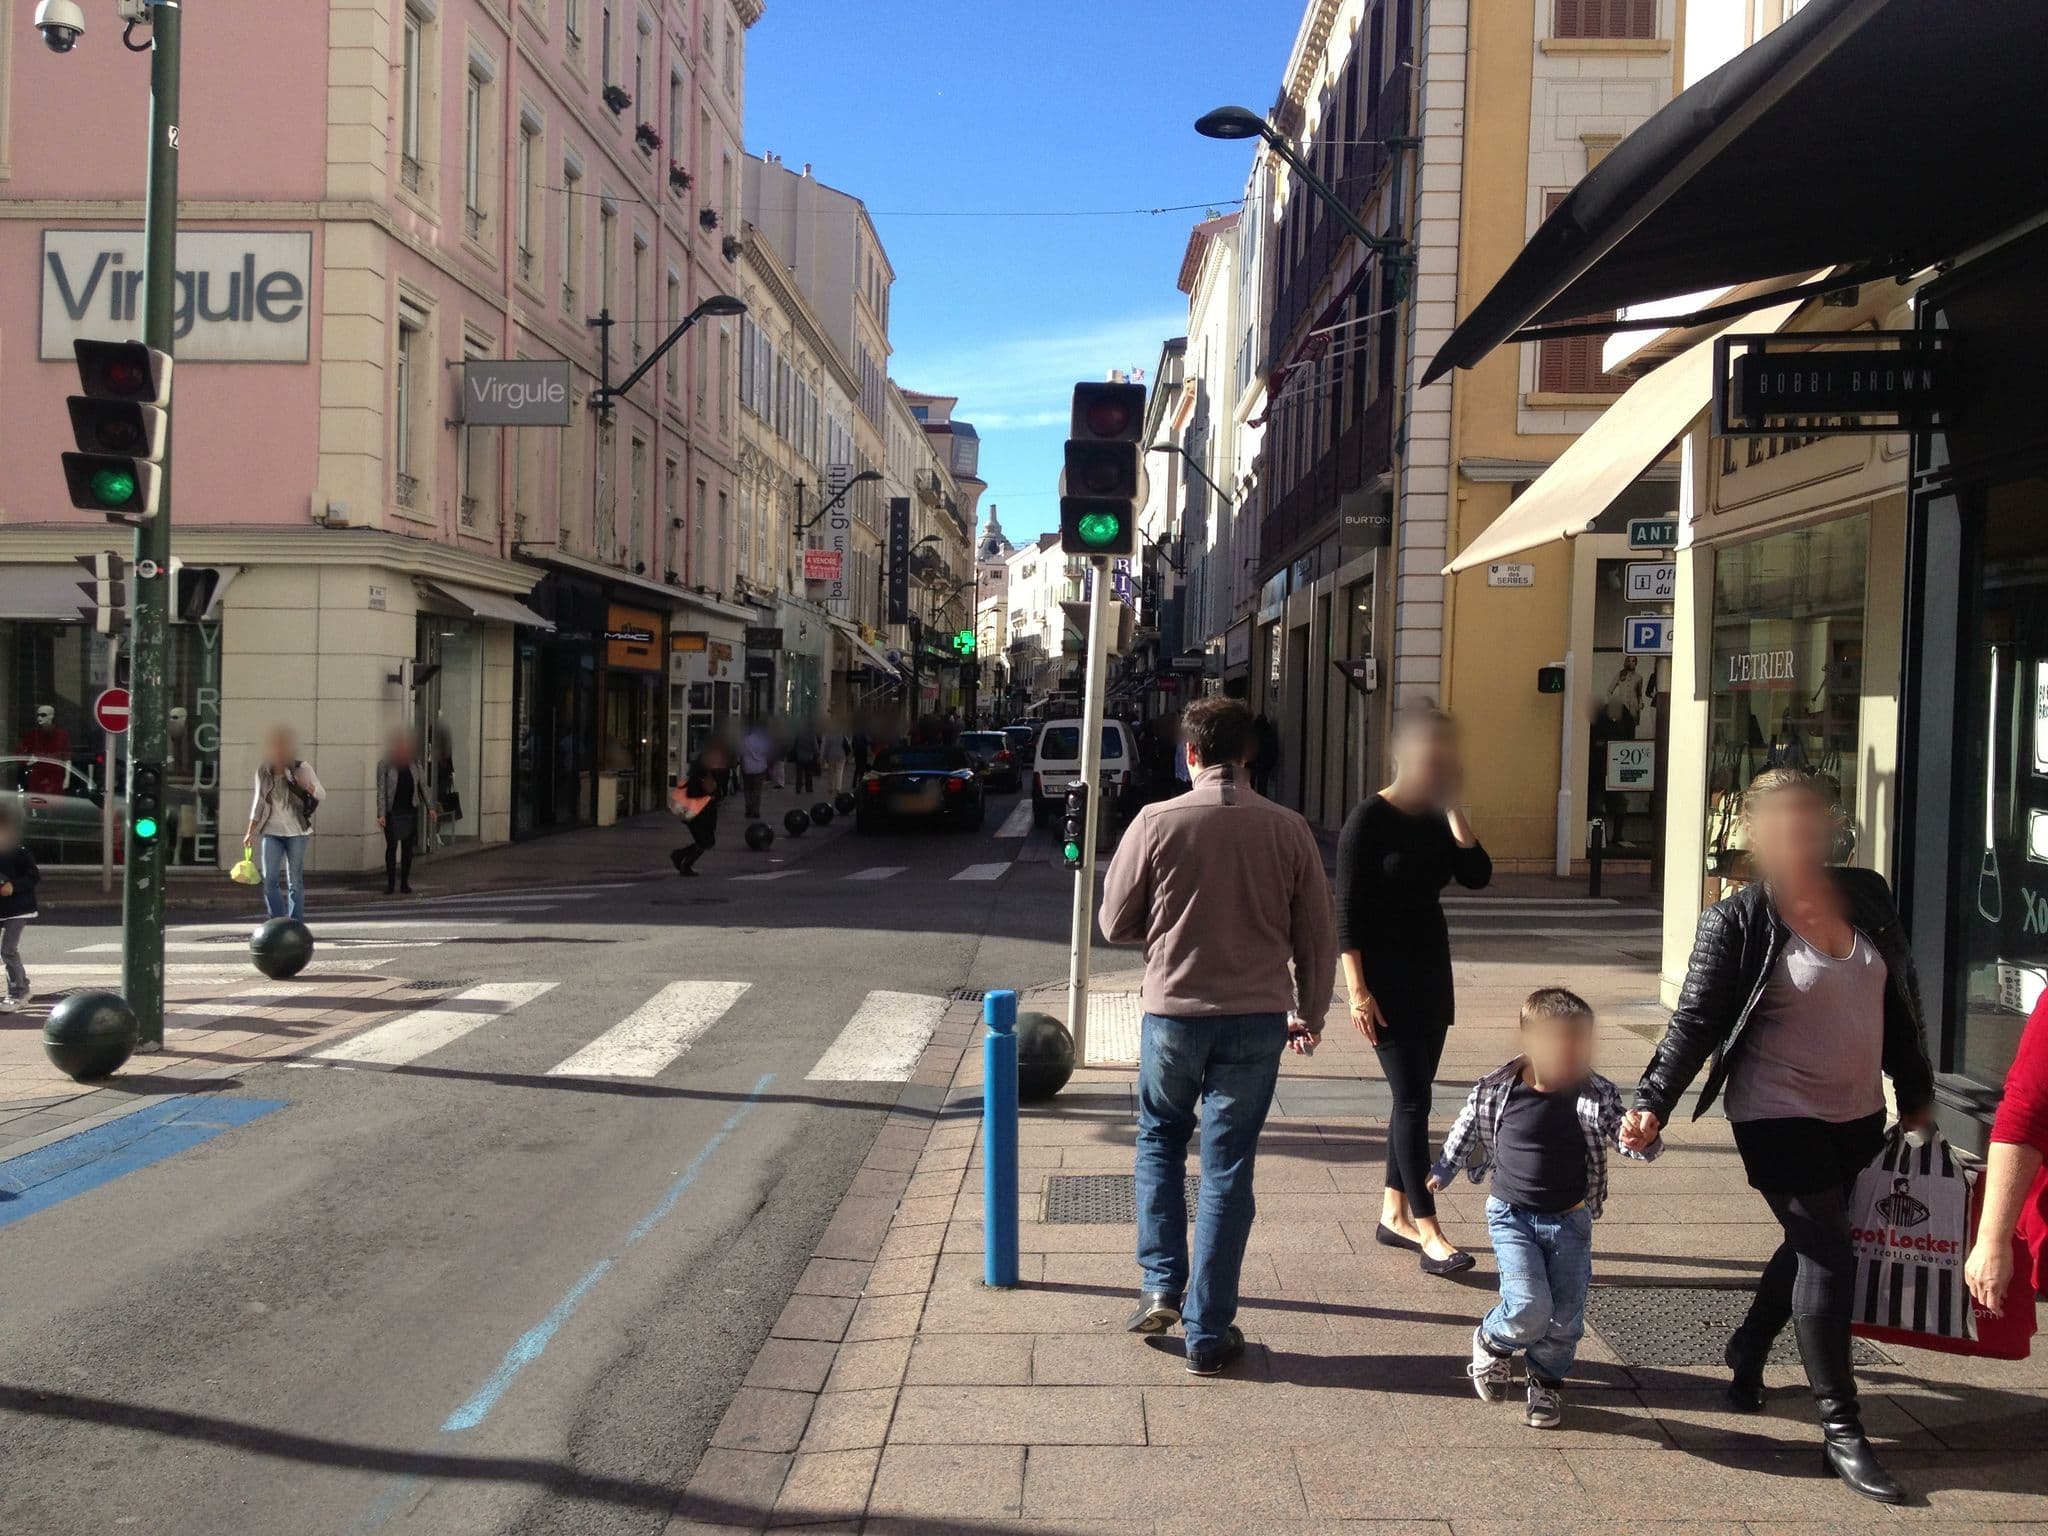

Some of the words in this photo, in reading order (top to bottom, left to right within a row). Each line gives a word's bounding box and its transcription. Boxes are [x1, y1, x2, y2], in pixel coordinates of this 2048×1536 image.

[471, 377, 565, 409] Virgule
[1760, 372, 1832, 394] BOBBI
[1852, 369, 1932, 392] BROWN
[1345, 516, 1391, 525] BURTON
[1656, 584, 1671, 595] du
[1729, 650, 1795, 682] L'ETRIER
[194, 624, 220, 863] VIRGULE
[1849, 1222, 1886, 1247] oot
[1889, 1228, 1960, 1255] Locker
